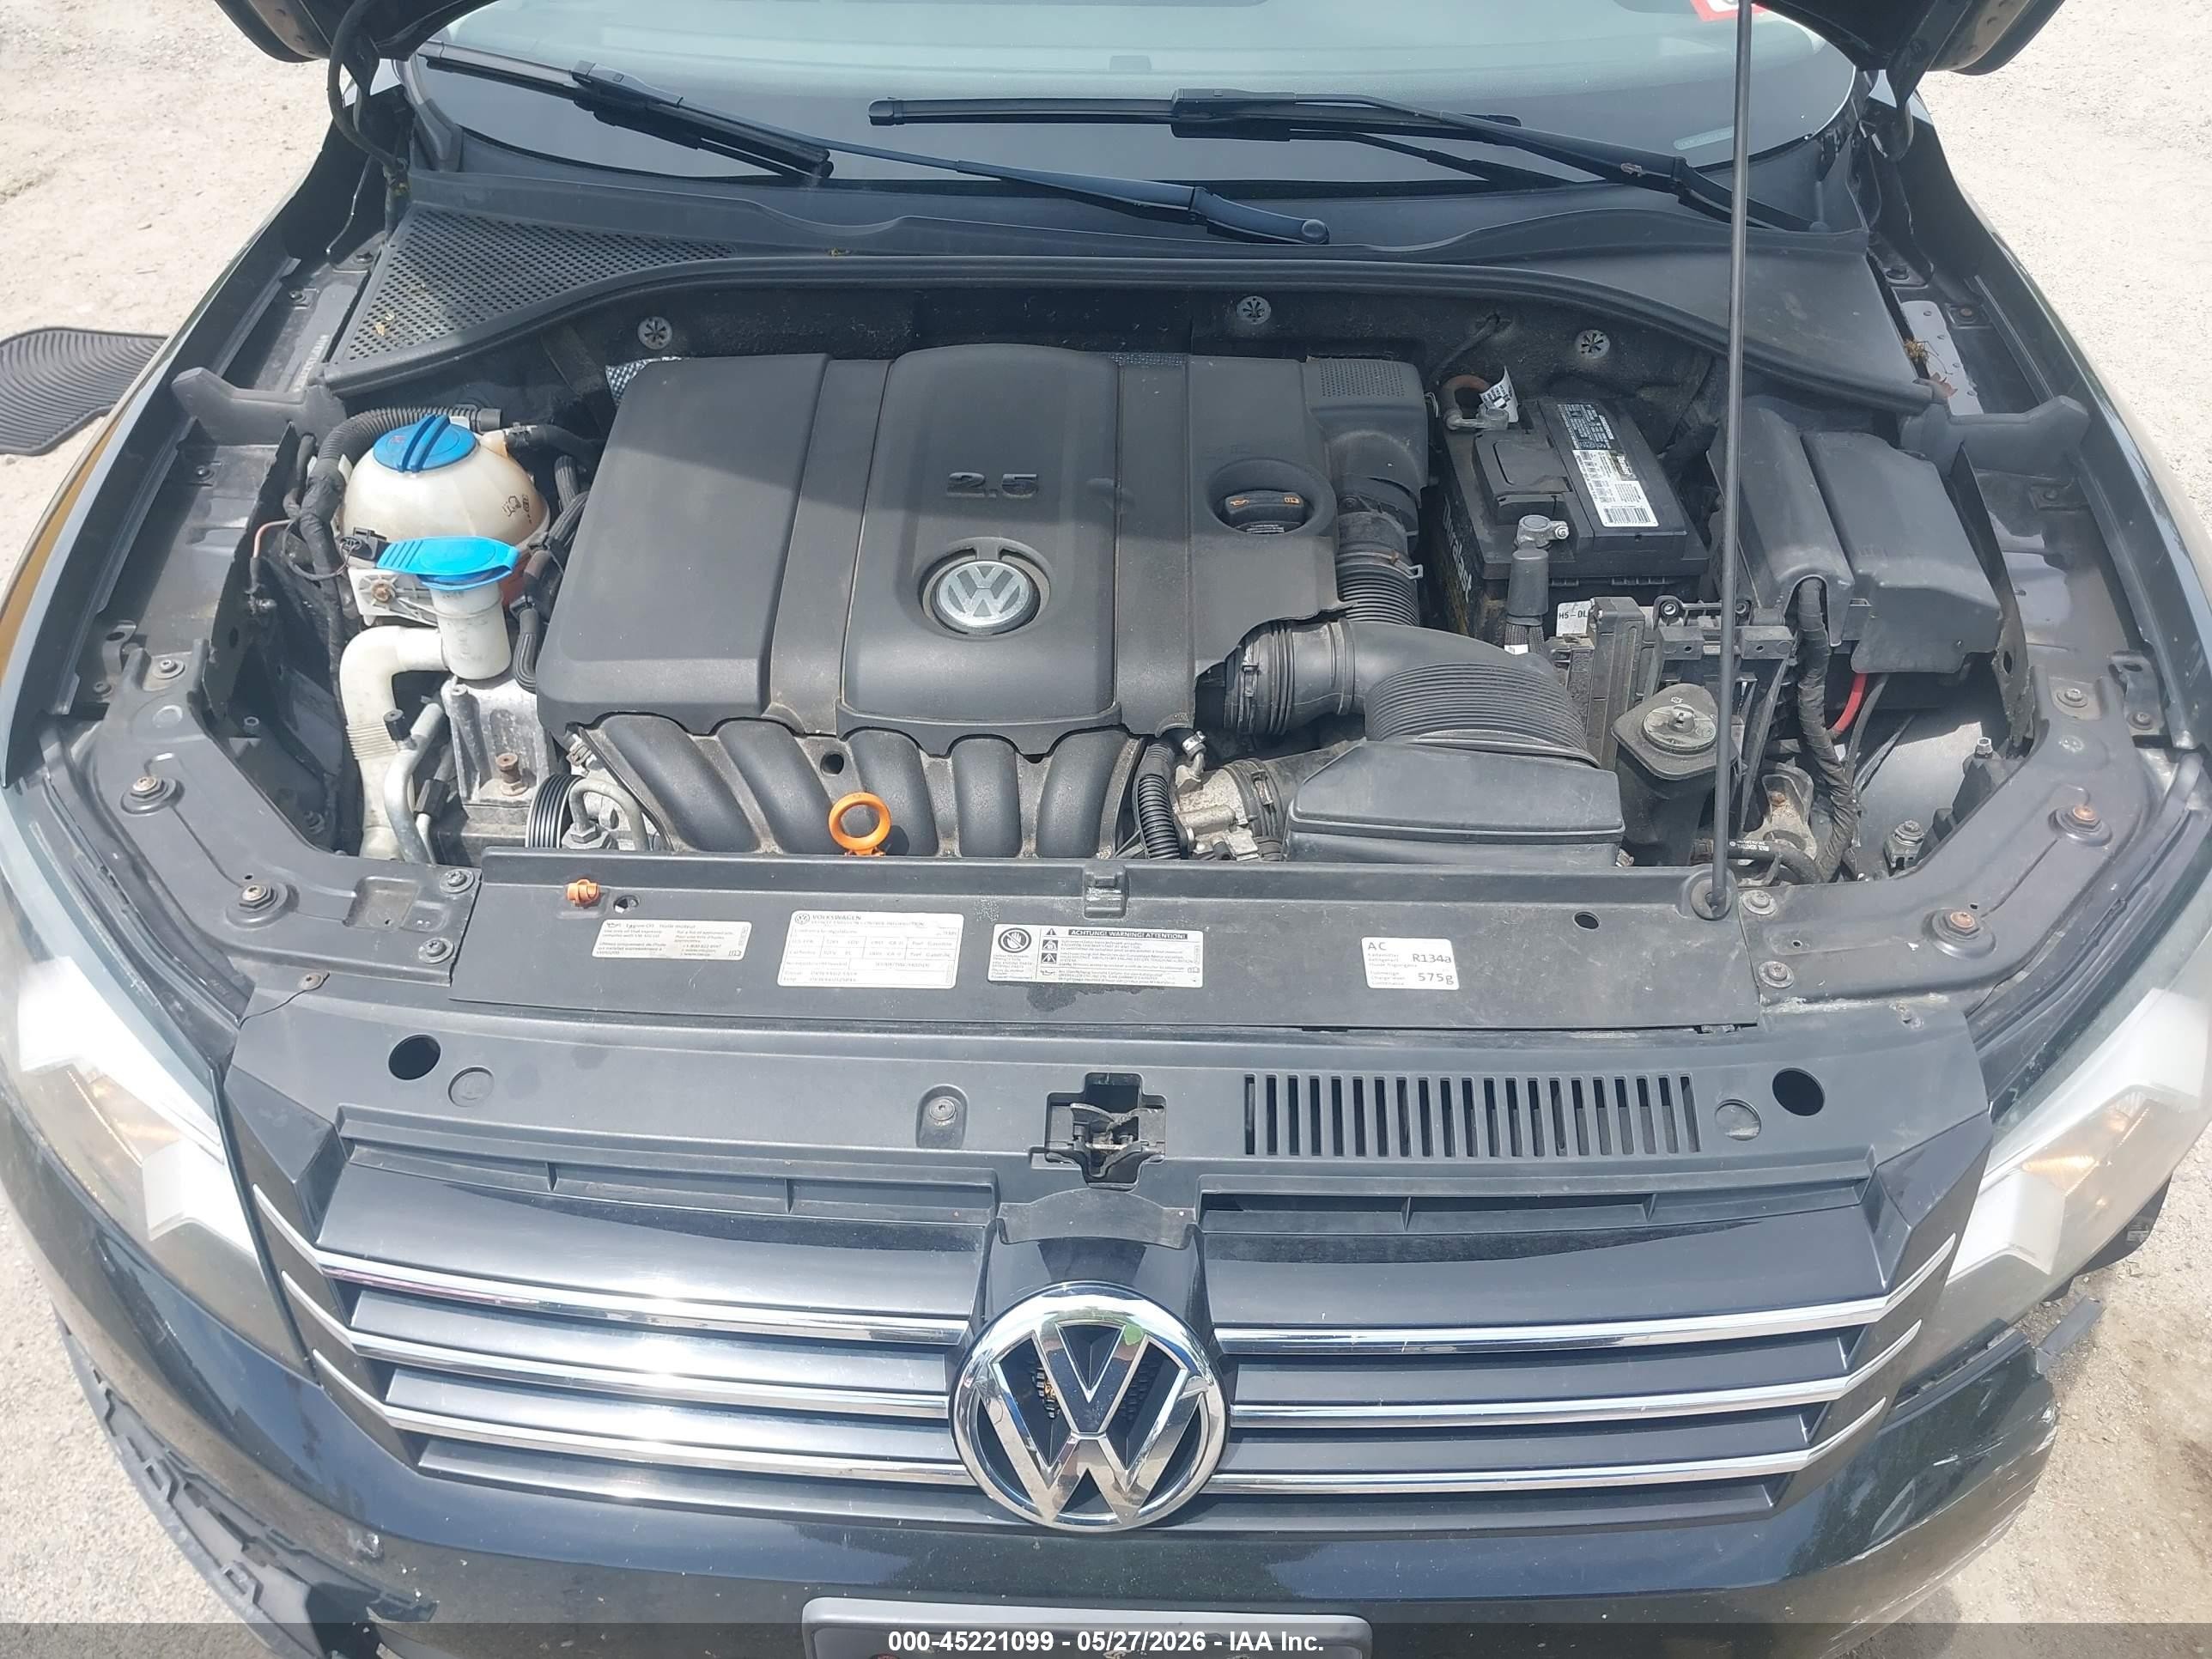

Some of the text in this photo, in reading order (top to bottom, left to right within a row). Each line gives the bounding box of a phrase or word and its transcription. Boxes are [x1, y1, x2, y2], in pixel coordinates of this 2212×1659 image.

[946, 471, 1038, 499] 2.5
[1146, 932, 1186, 940] ATTENTION!
[1368, 941, 1387, 951] AC
[1413, 953, 1451, 963] R134a
[1418, 972, 1455, 986] 575g
